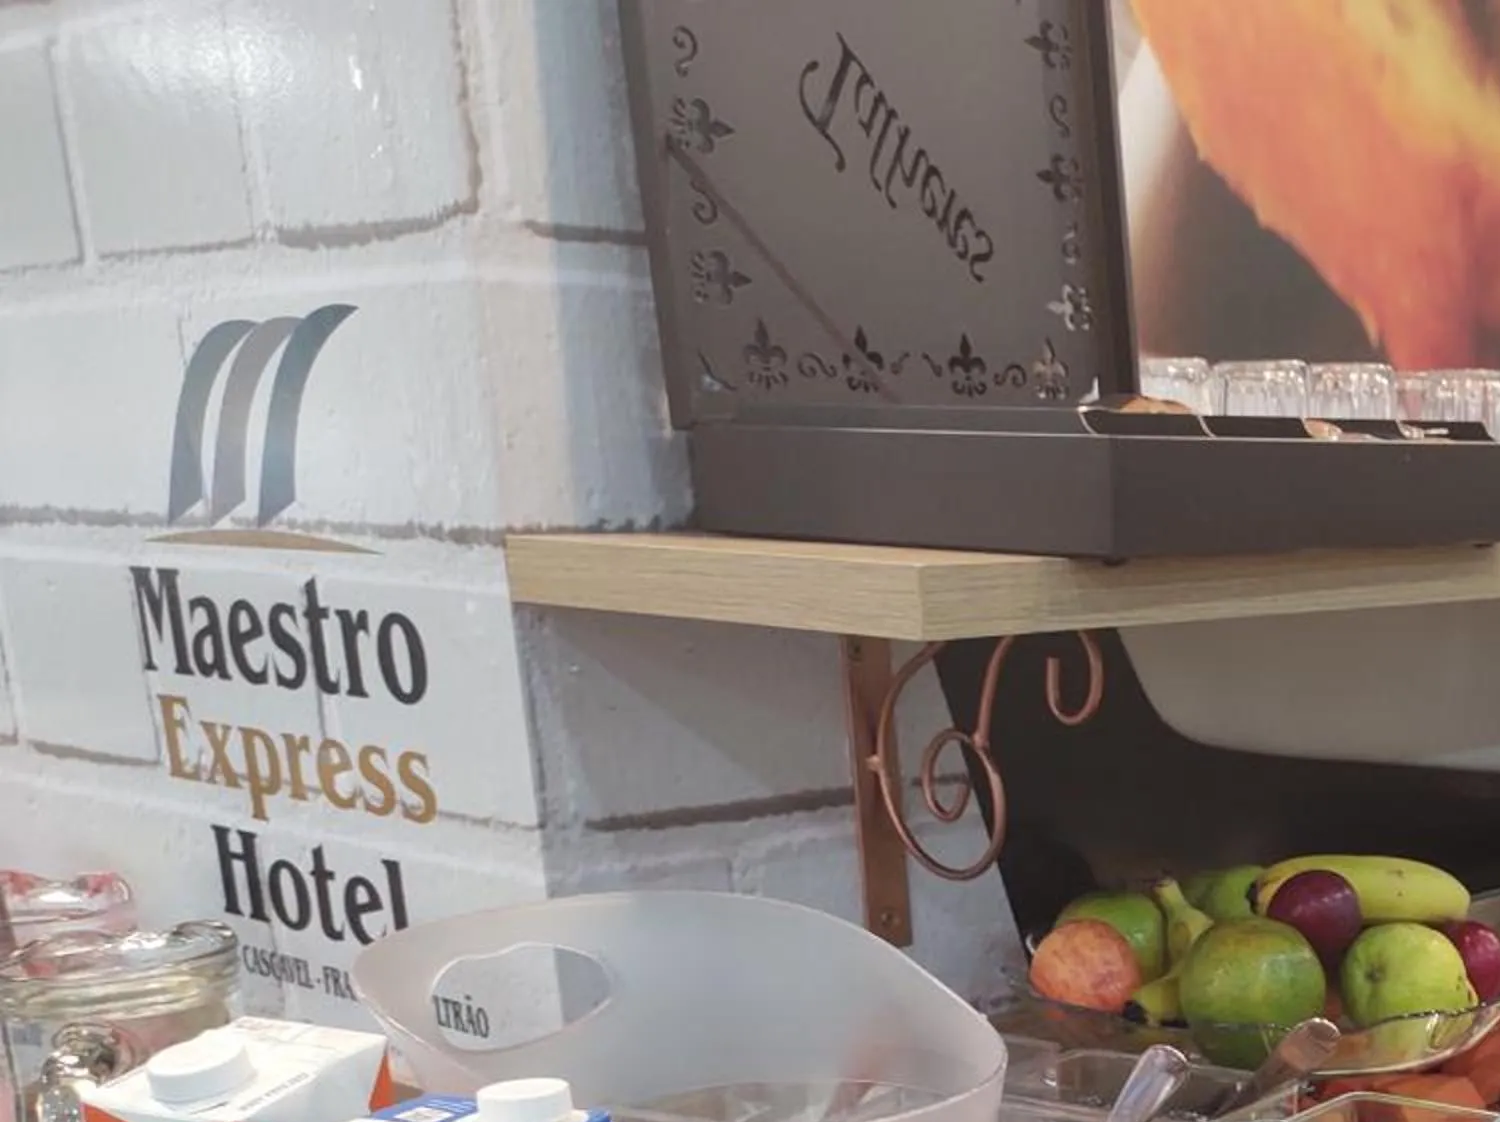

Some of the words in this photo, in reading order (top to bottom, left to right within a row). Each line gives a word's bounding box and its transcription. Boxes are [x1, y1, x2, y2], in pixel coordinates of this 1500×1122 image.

[129, 565, 429, 706] Maestro
[156, 693, 438, 824] Express
[211, 823, 410, 946] Hotel
